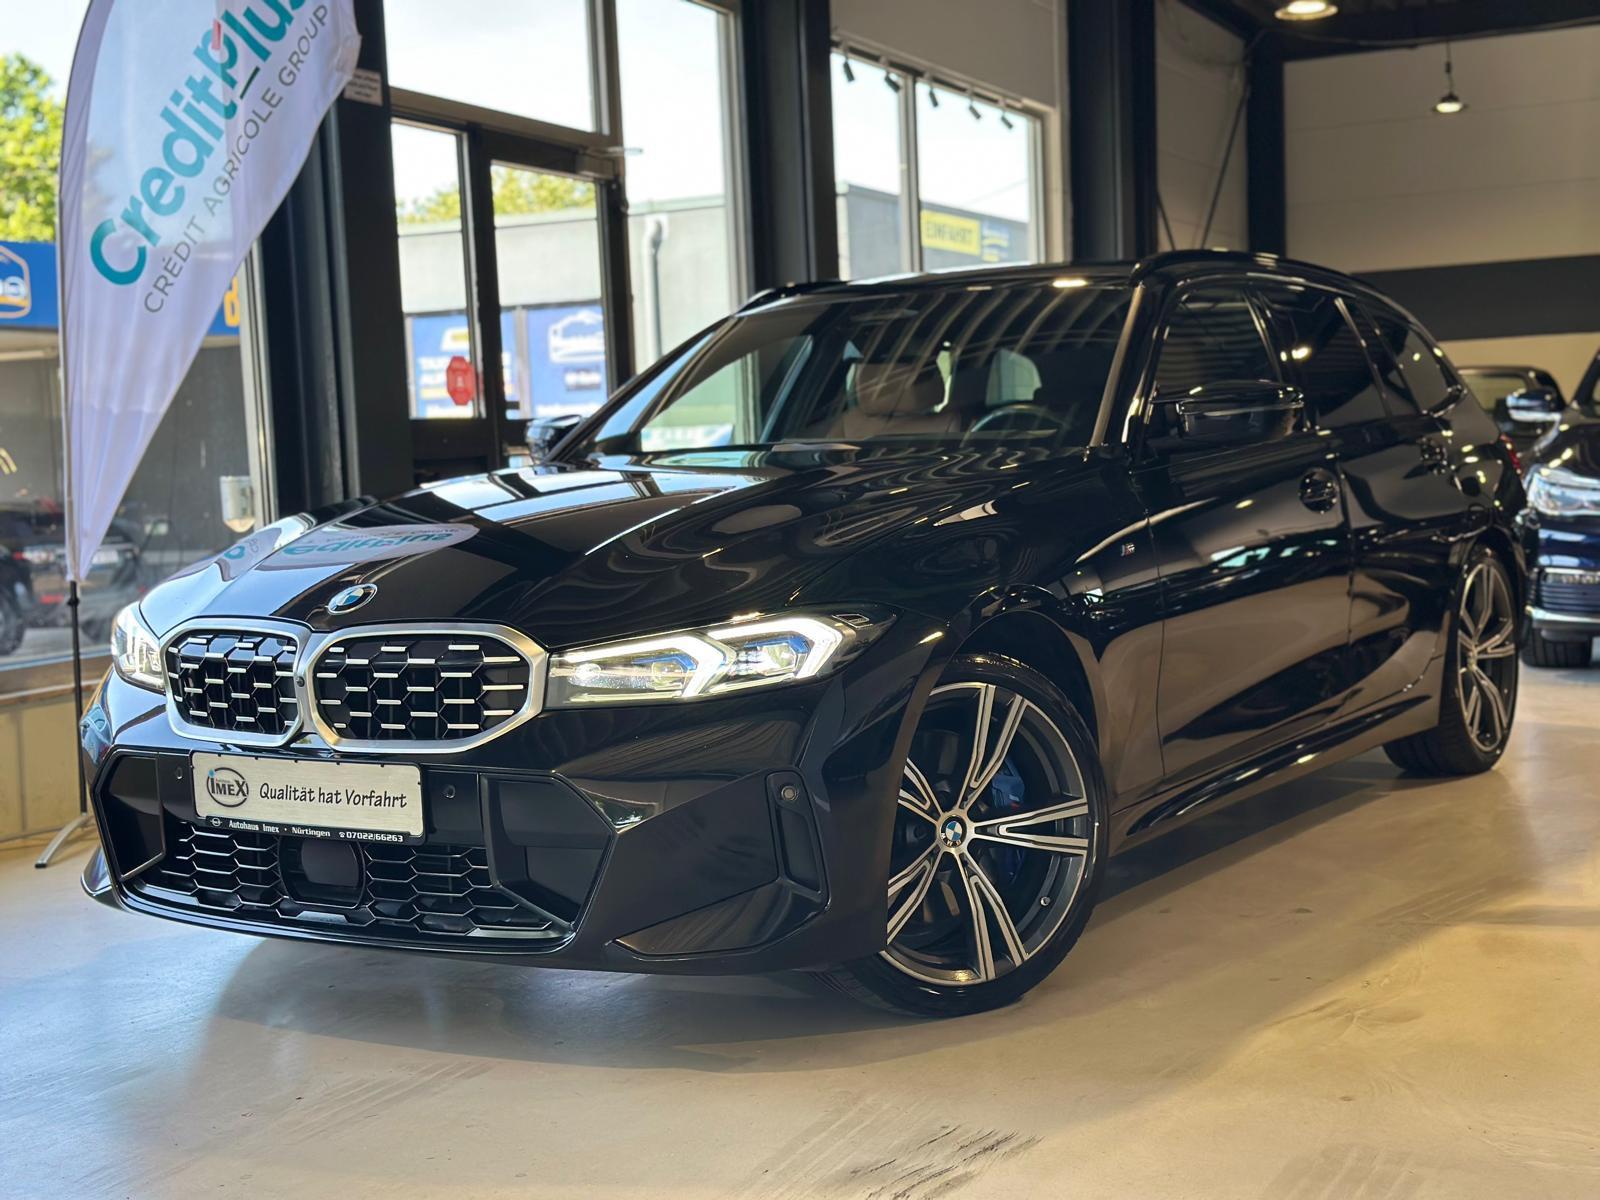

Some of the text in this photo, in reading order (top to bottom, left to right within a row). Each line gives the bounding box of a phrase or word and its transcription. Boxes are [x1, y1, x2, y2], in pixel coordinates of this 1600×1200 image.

[144, 4, 328, 313] CRÉDIT AGRICOLE GROUP
[259, 782, 408, 808] Qualität hat Vorfahrt
[228, 820, 259, 831] Autohaus
[263, 824, 280, 833] Imex
[292, 826, 331, 837] Nürtingen
